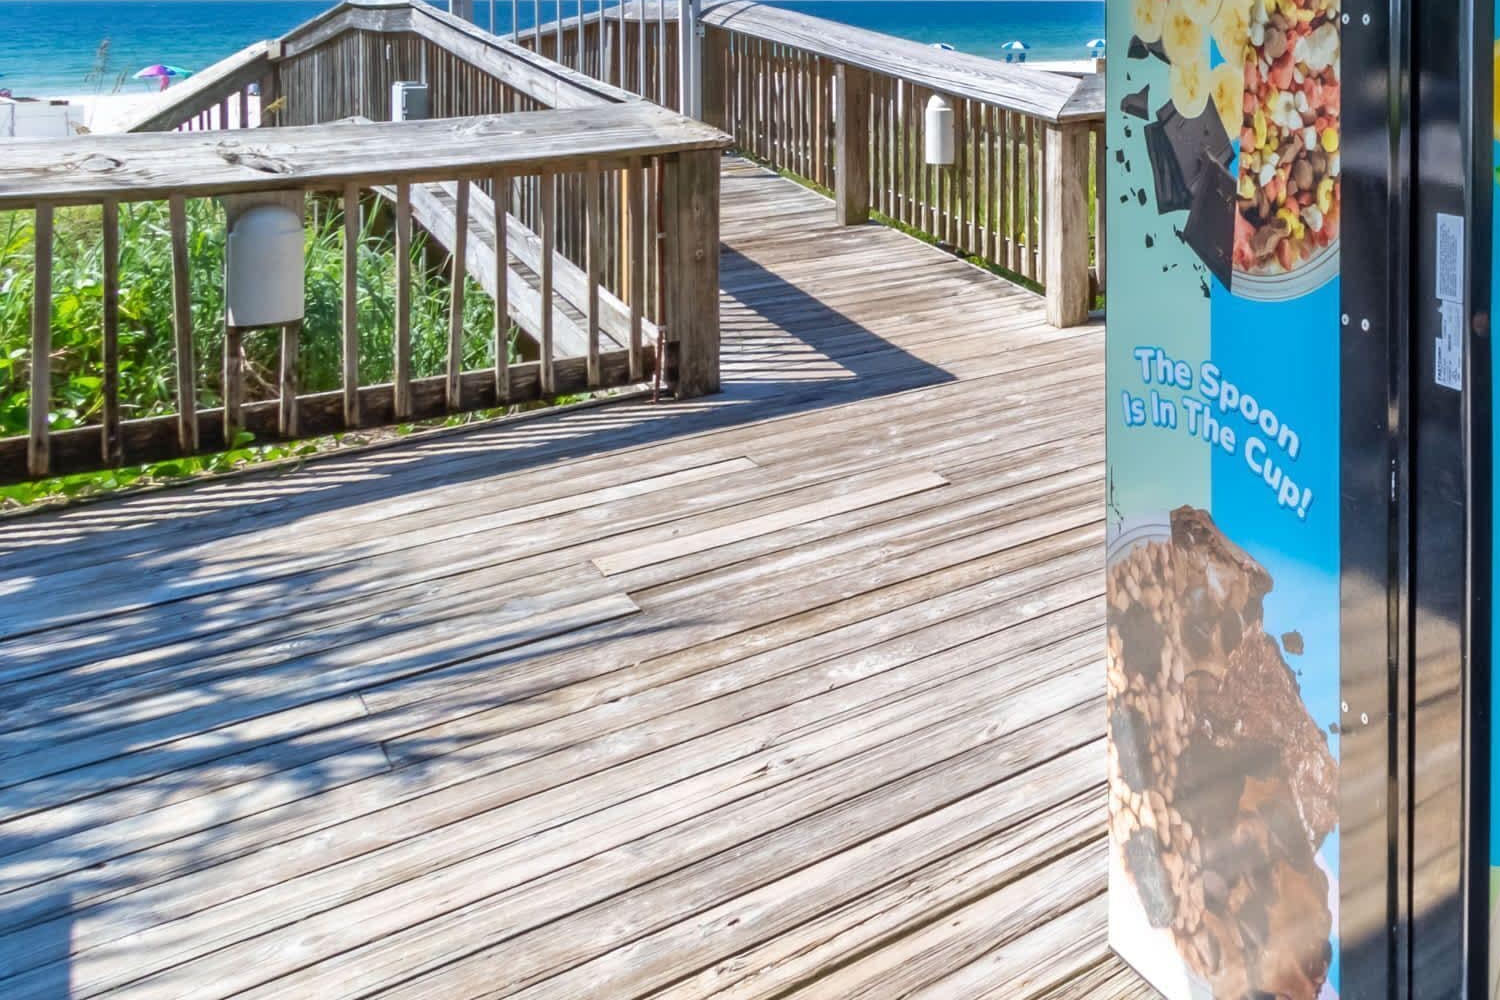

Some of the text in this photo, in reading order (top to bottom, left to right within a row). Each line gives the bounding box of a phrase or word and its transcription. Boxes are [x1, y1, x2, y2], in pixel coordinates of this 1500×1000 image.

[1122, 390, 1313, 520] Is In The Cup!
[1134, 347, 1301, 462] The Spoon
